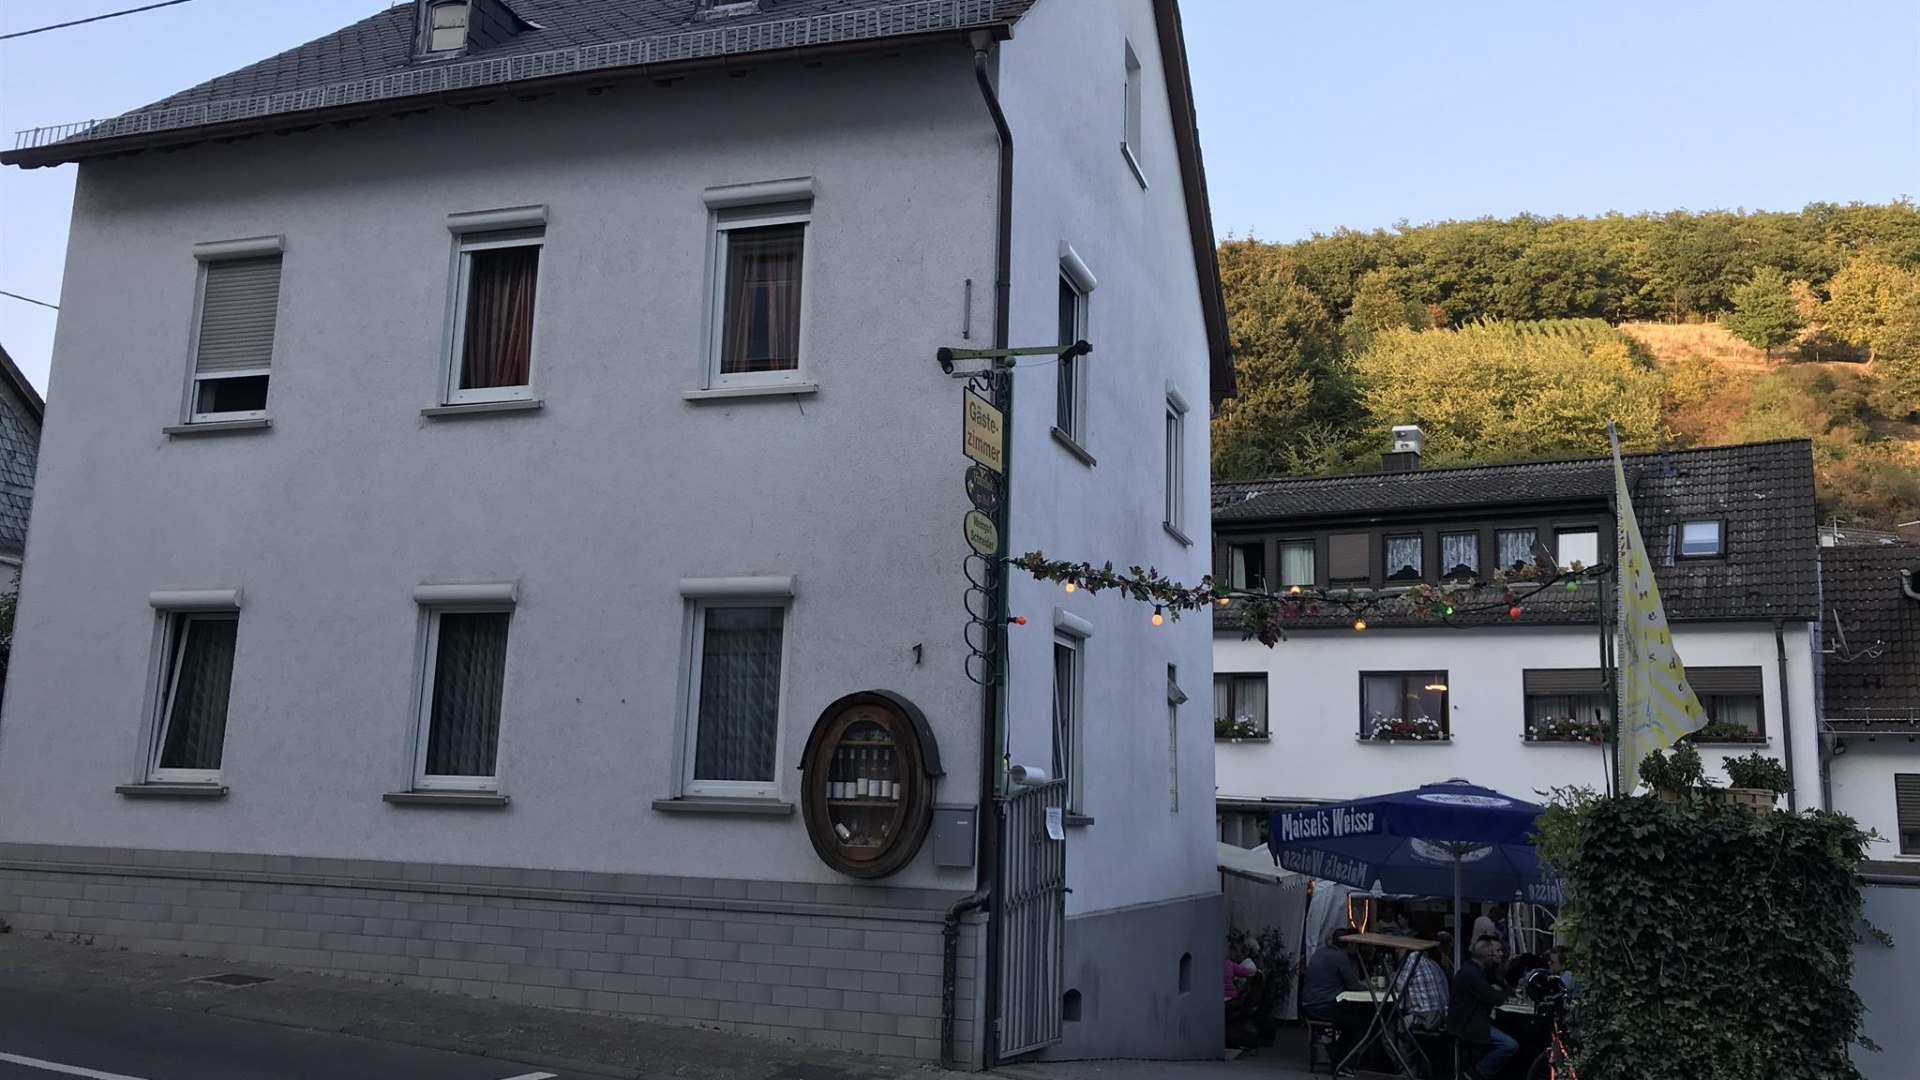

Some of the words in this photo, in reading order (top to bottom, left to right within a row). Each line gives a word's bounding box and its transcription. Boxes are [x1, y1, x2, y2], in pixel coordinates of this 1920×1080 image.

[969, 401, 999, 434] Gäste-
[967, 429, 1000, 463] zimmer
[970, 529, 994, 550] Schneider
[973, 514, 993, 535] Weingut
[1281, 810, 1330, 842] Maisel's
[1332, 806, 1375, 837] Weisse
